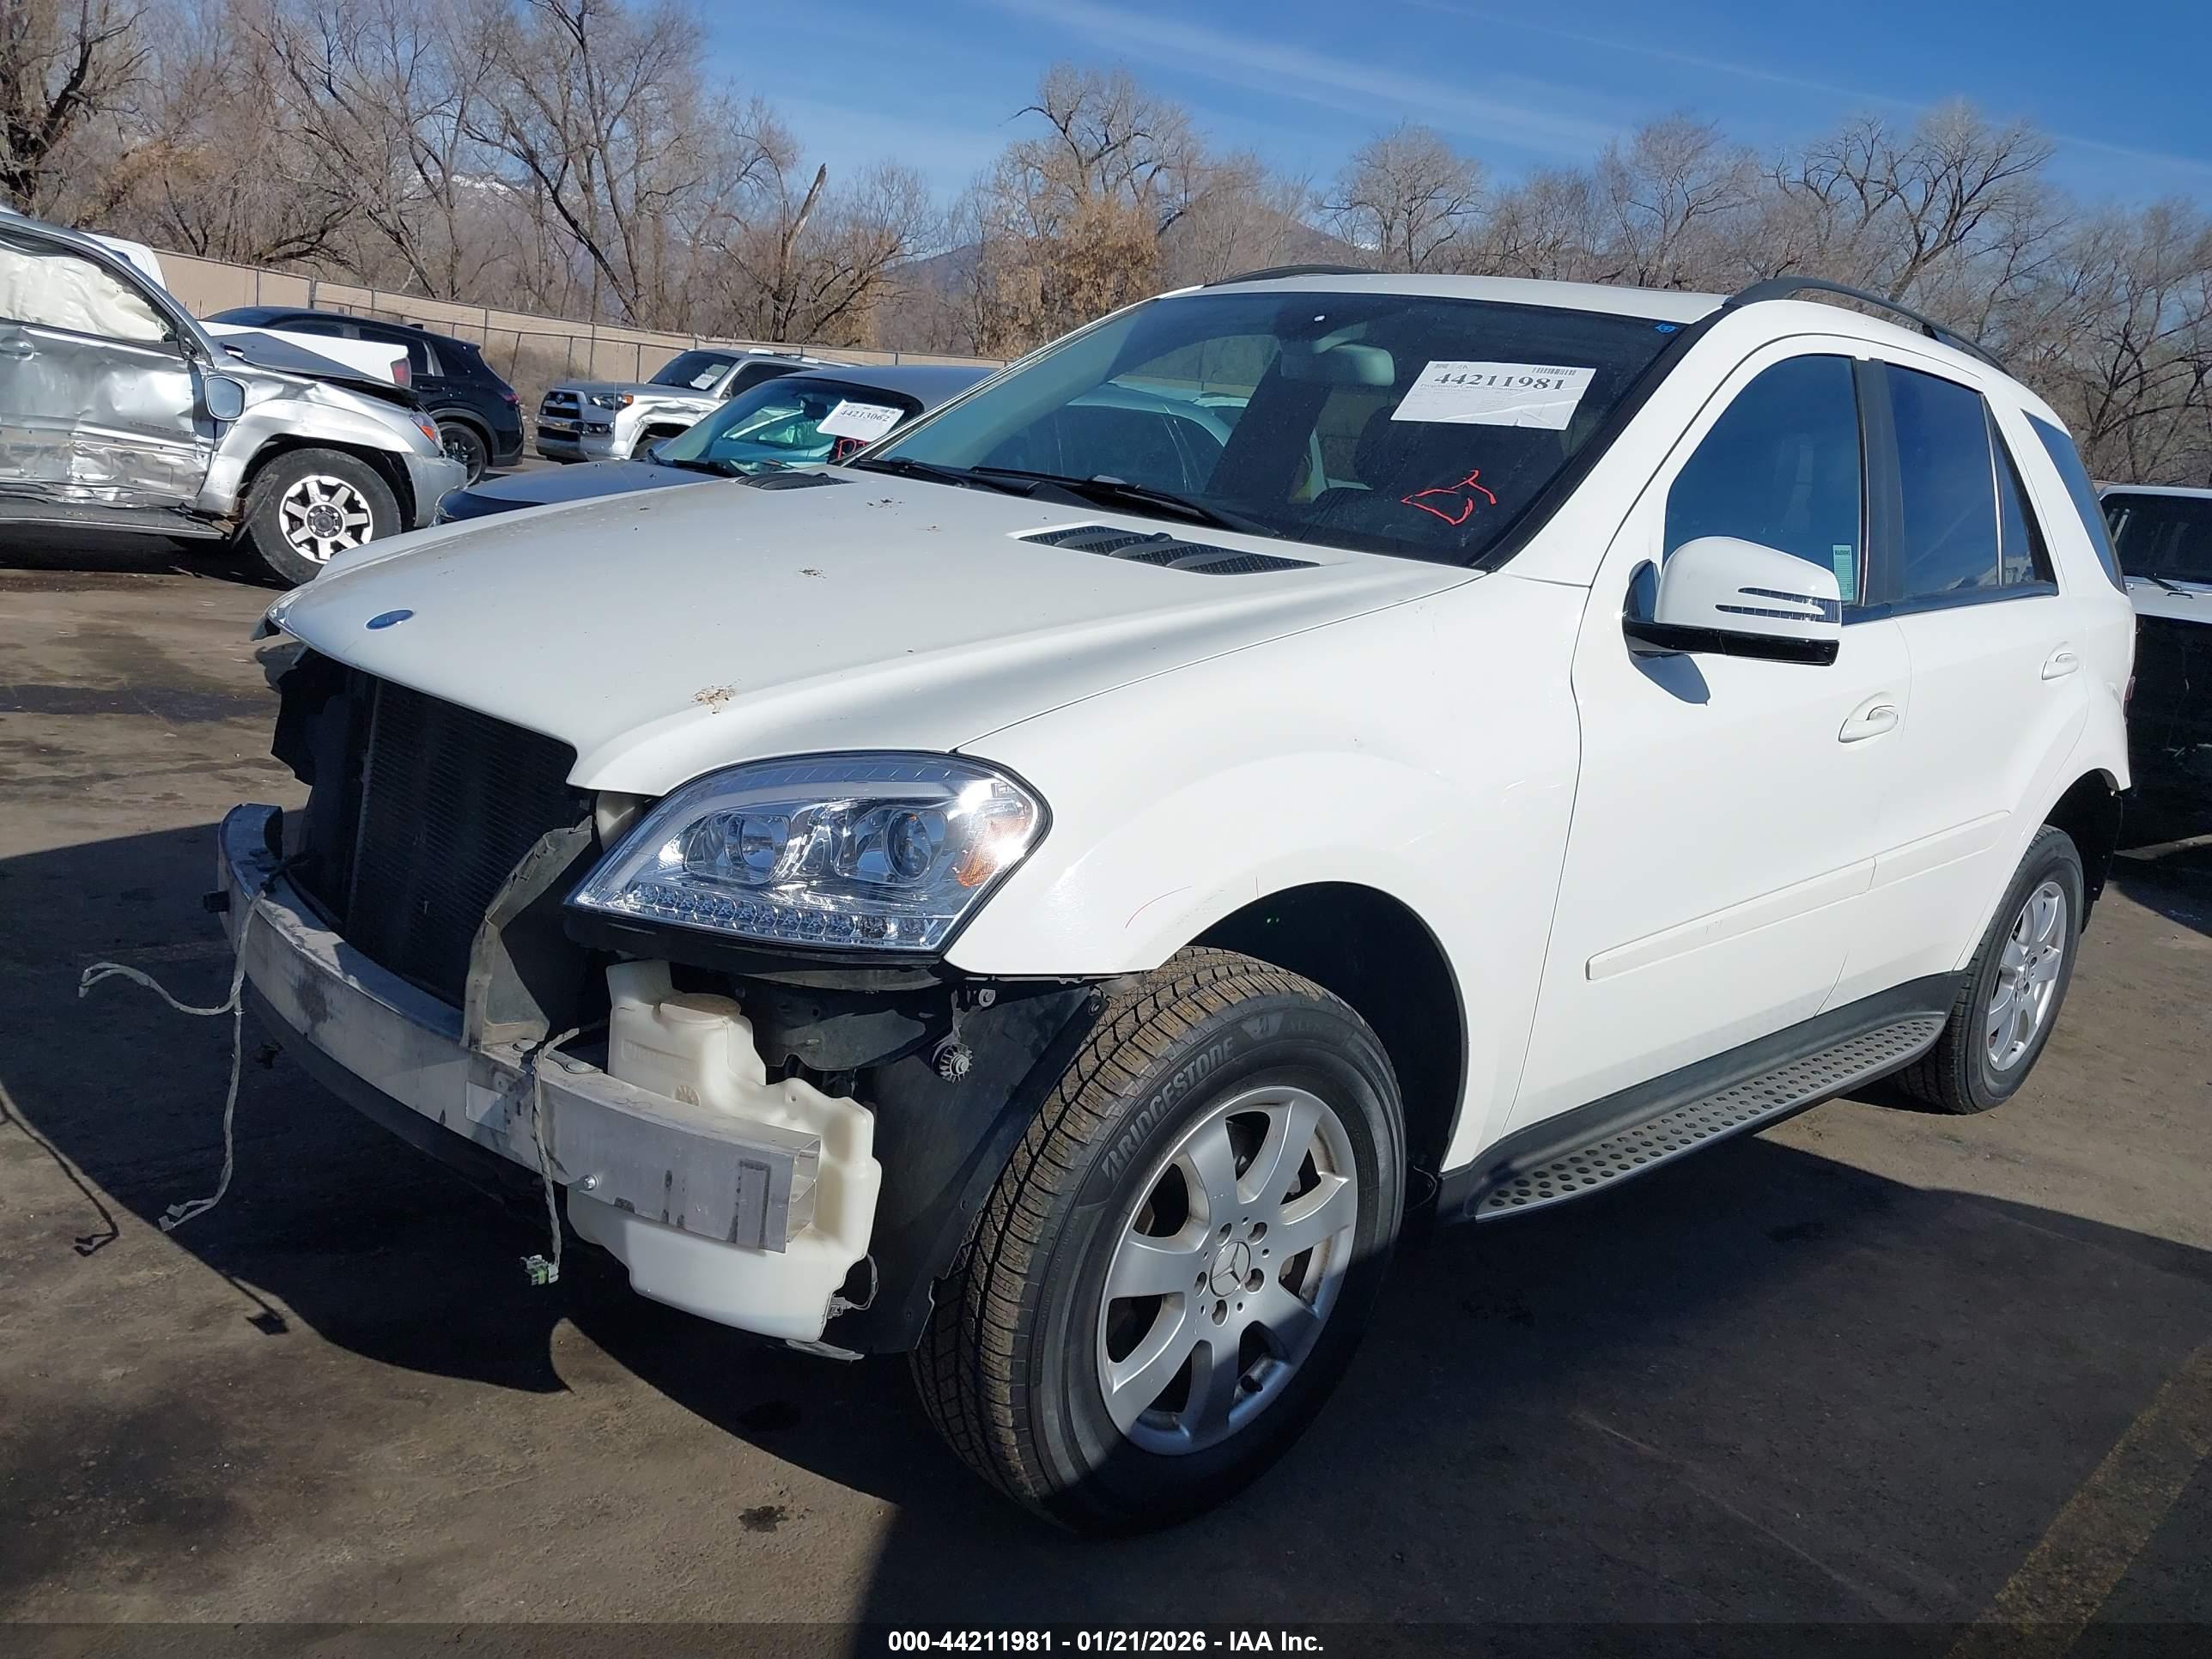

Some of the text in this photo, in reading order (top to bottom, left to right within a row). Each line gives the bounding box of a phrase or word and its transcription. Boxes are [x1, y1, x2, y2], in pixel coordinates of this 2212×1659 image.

[1434, 373, 1565, 390] 44211981
[841, 410, 890, 422] 44213062
[1101, 1036, 1234, 1182] BRIDGESTONE
